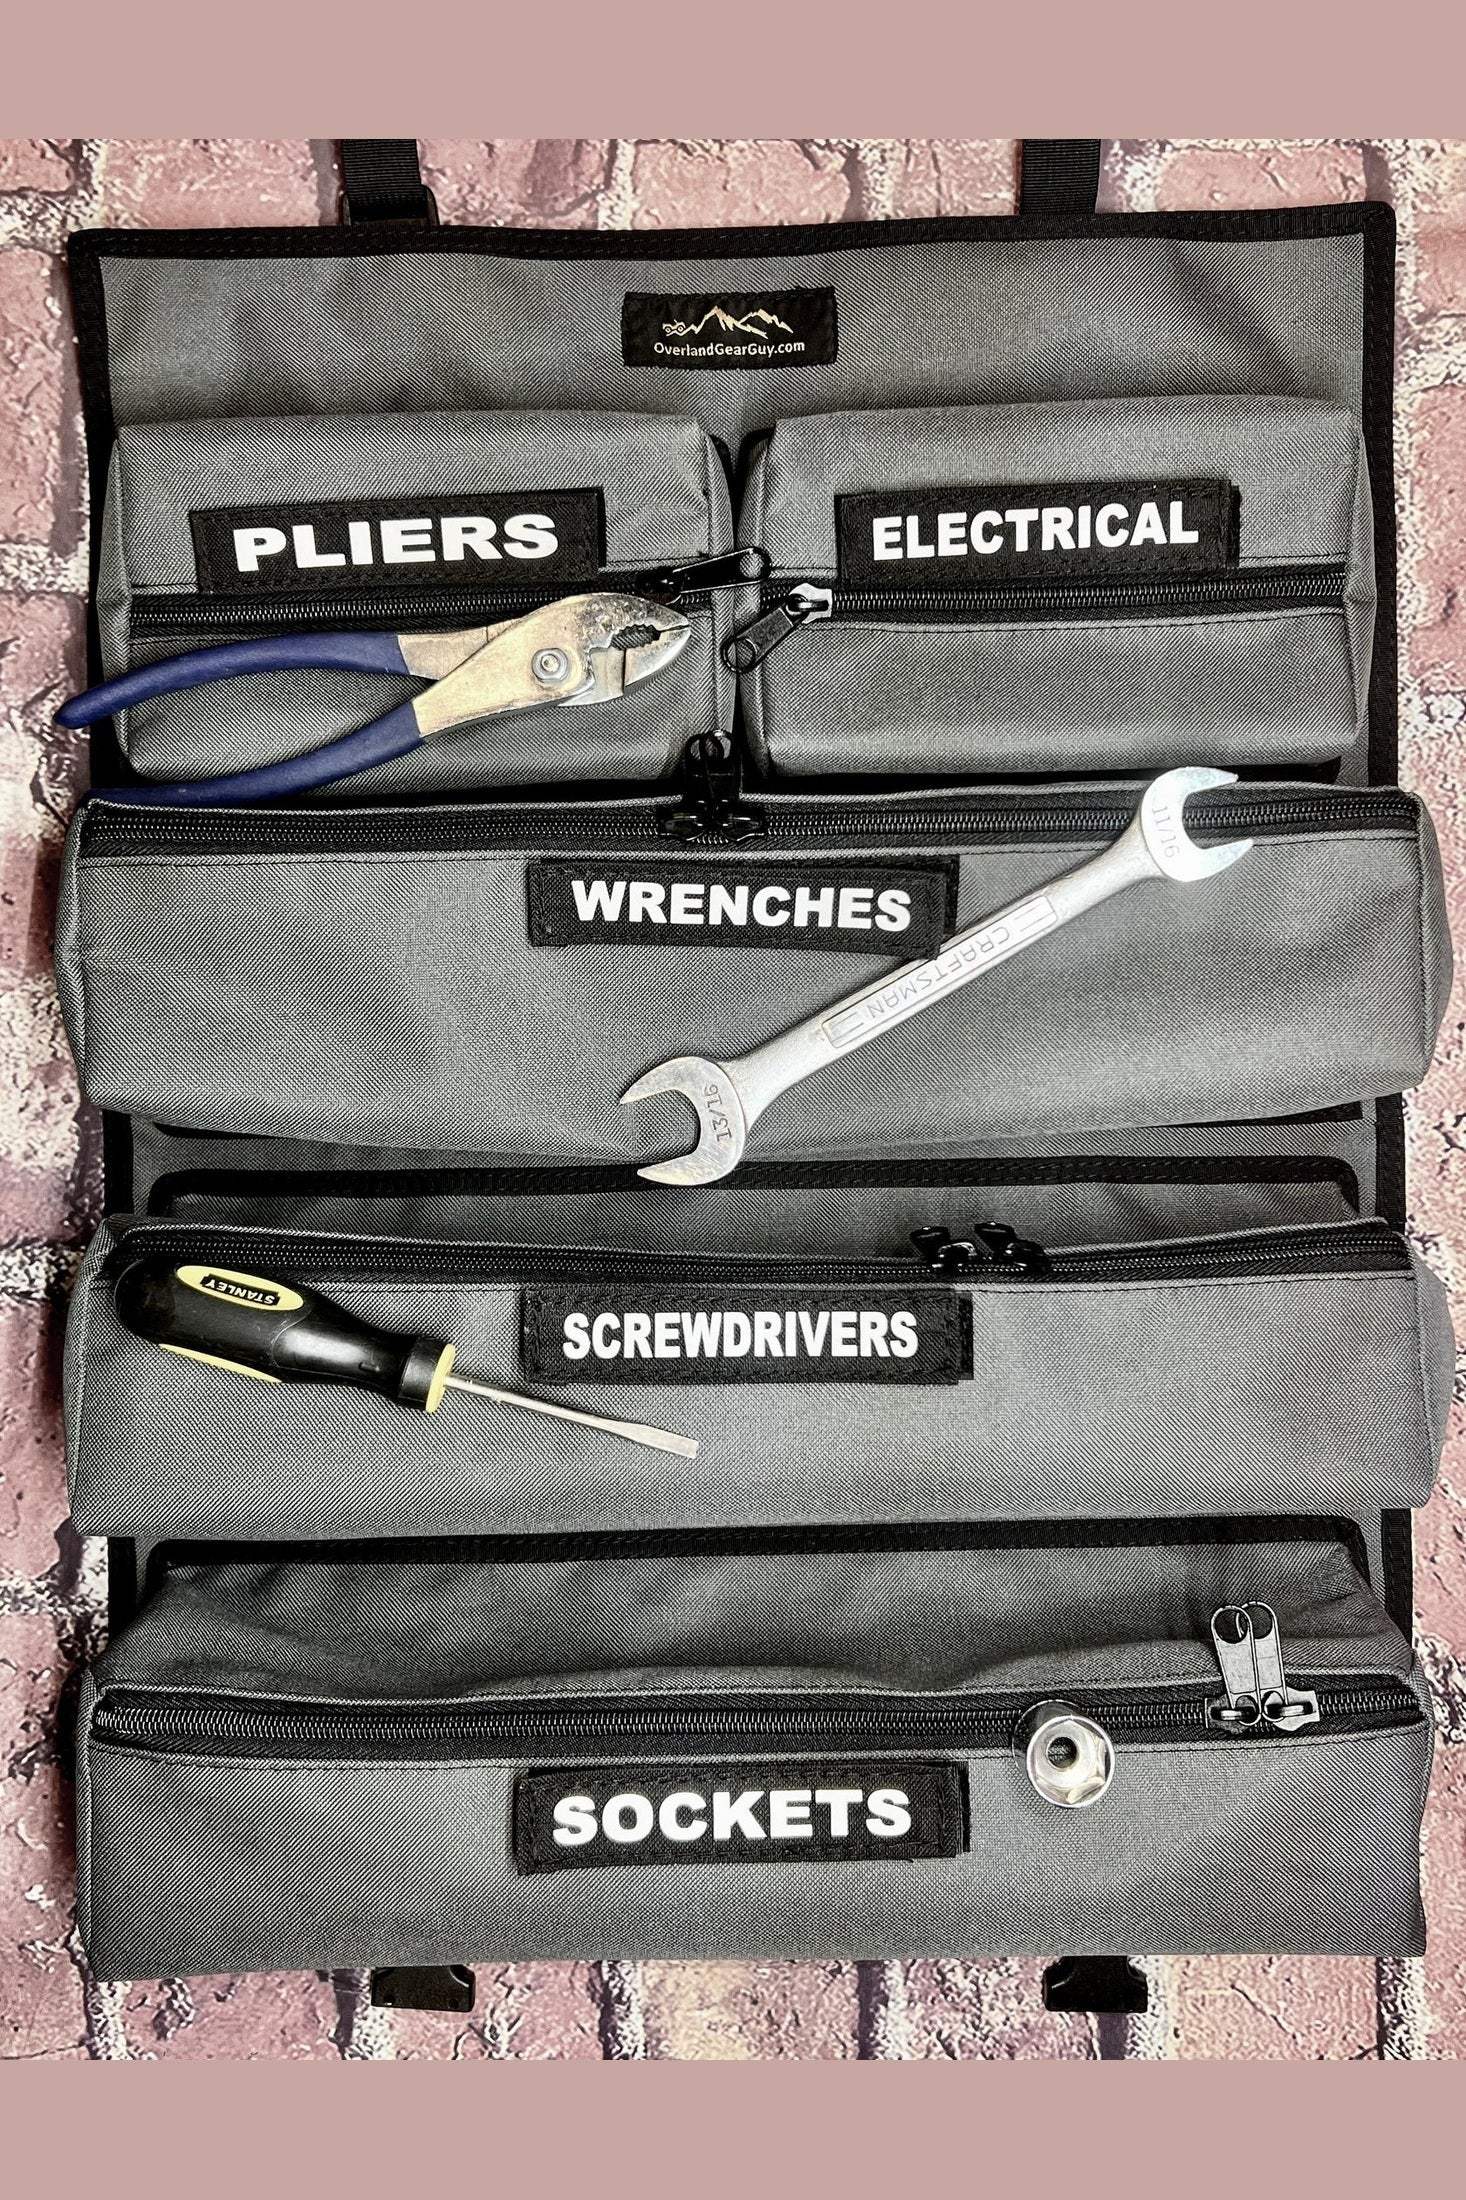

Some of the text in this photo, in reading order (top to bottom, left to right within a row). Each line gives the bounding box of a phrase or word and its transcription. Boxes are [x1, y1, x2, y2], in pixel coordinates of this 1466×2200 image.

[653, 341, 806, 358] OverlandGearGuy.com
[233, 514, 558, 573] PLIERS
[873, 501, 1199, 561] ELECTRICAL
[1152, 803, 1180, 858] 11/16
[571, 880, 911, 932] WRENCHES
[866, 926, 1010, 1019] CRAFTSMAN
[703, 1083, 733, 1142] 13/16
[205, 1278, 276, 1305] STANLEY
[562, 1309, 919, 1360] SCREWDRIVERS
[552, 1788, 912, 1848] SOCKETS
